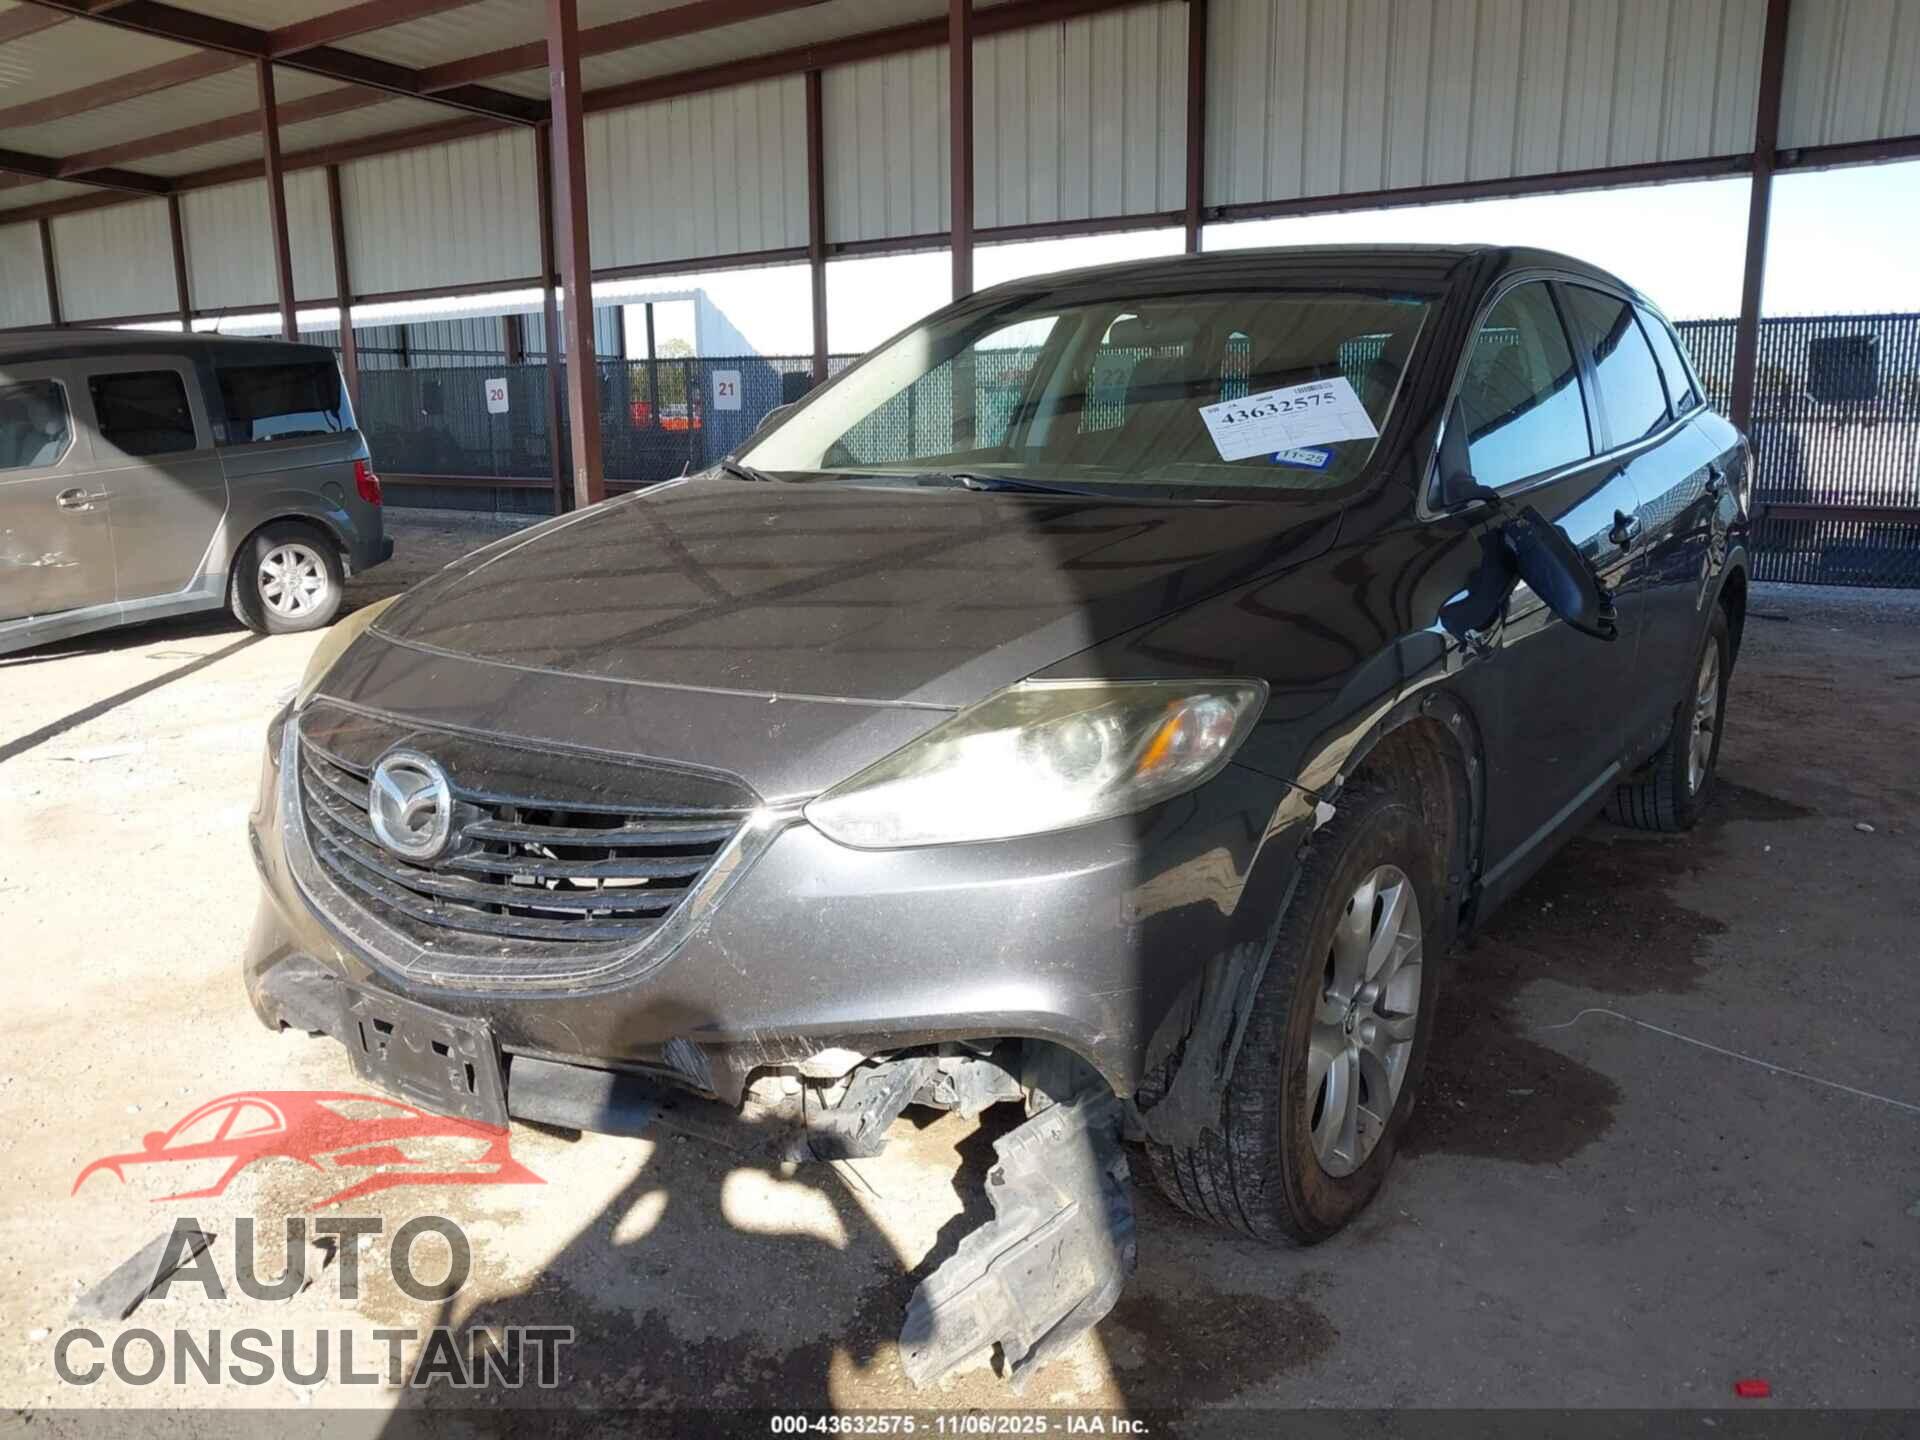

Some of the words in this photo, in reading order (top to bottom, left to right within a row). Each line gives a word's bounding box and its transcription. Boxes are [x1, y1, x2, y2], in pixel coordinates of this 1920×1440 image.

[490, 389, 505, 401] 20
[719, 383, 735, 396] 21
[1221, 392, 1337, 424] 43632575
[1283, 451, 1323, 463] 11-25
